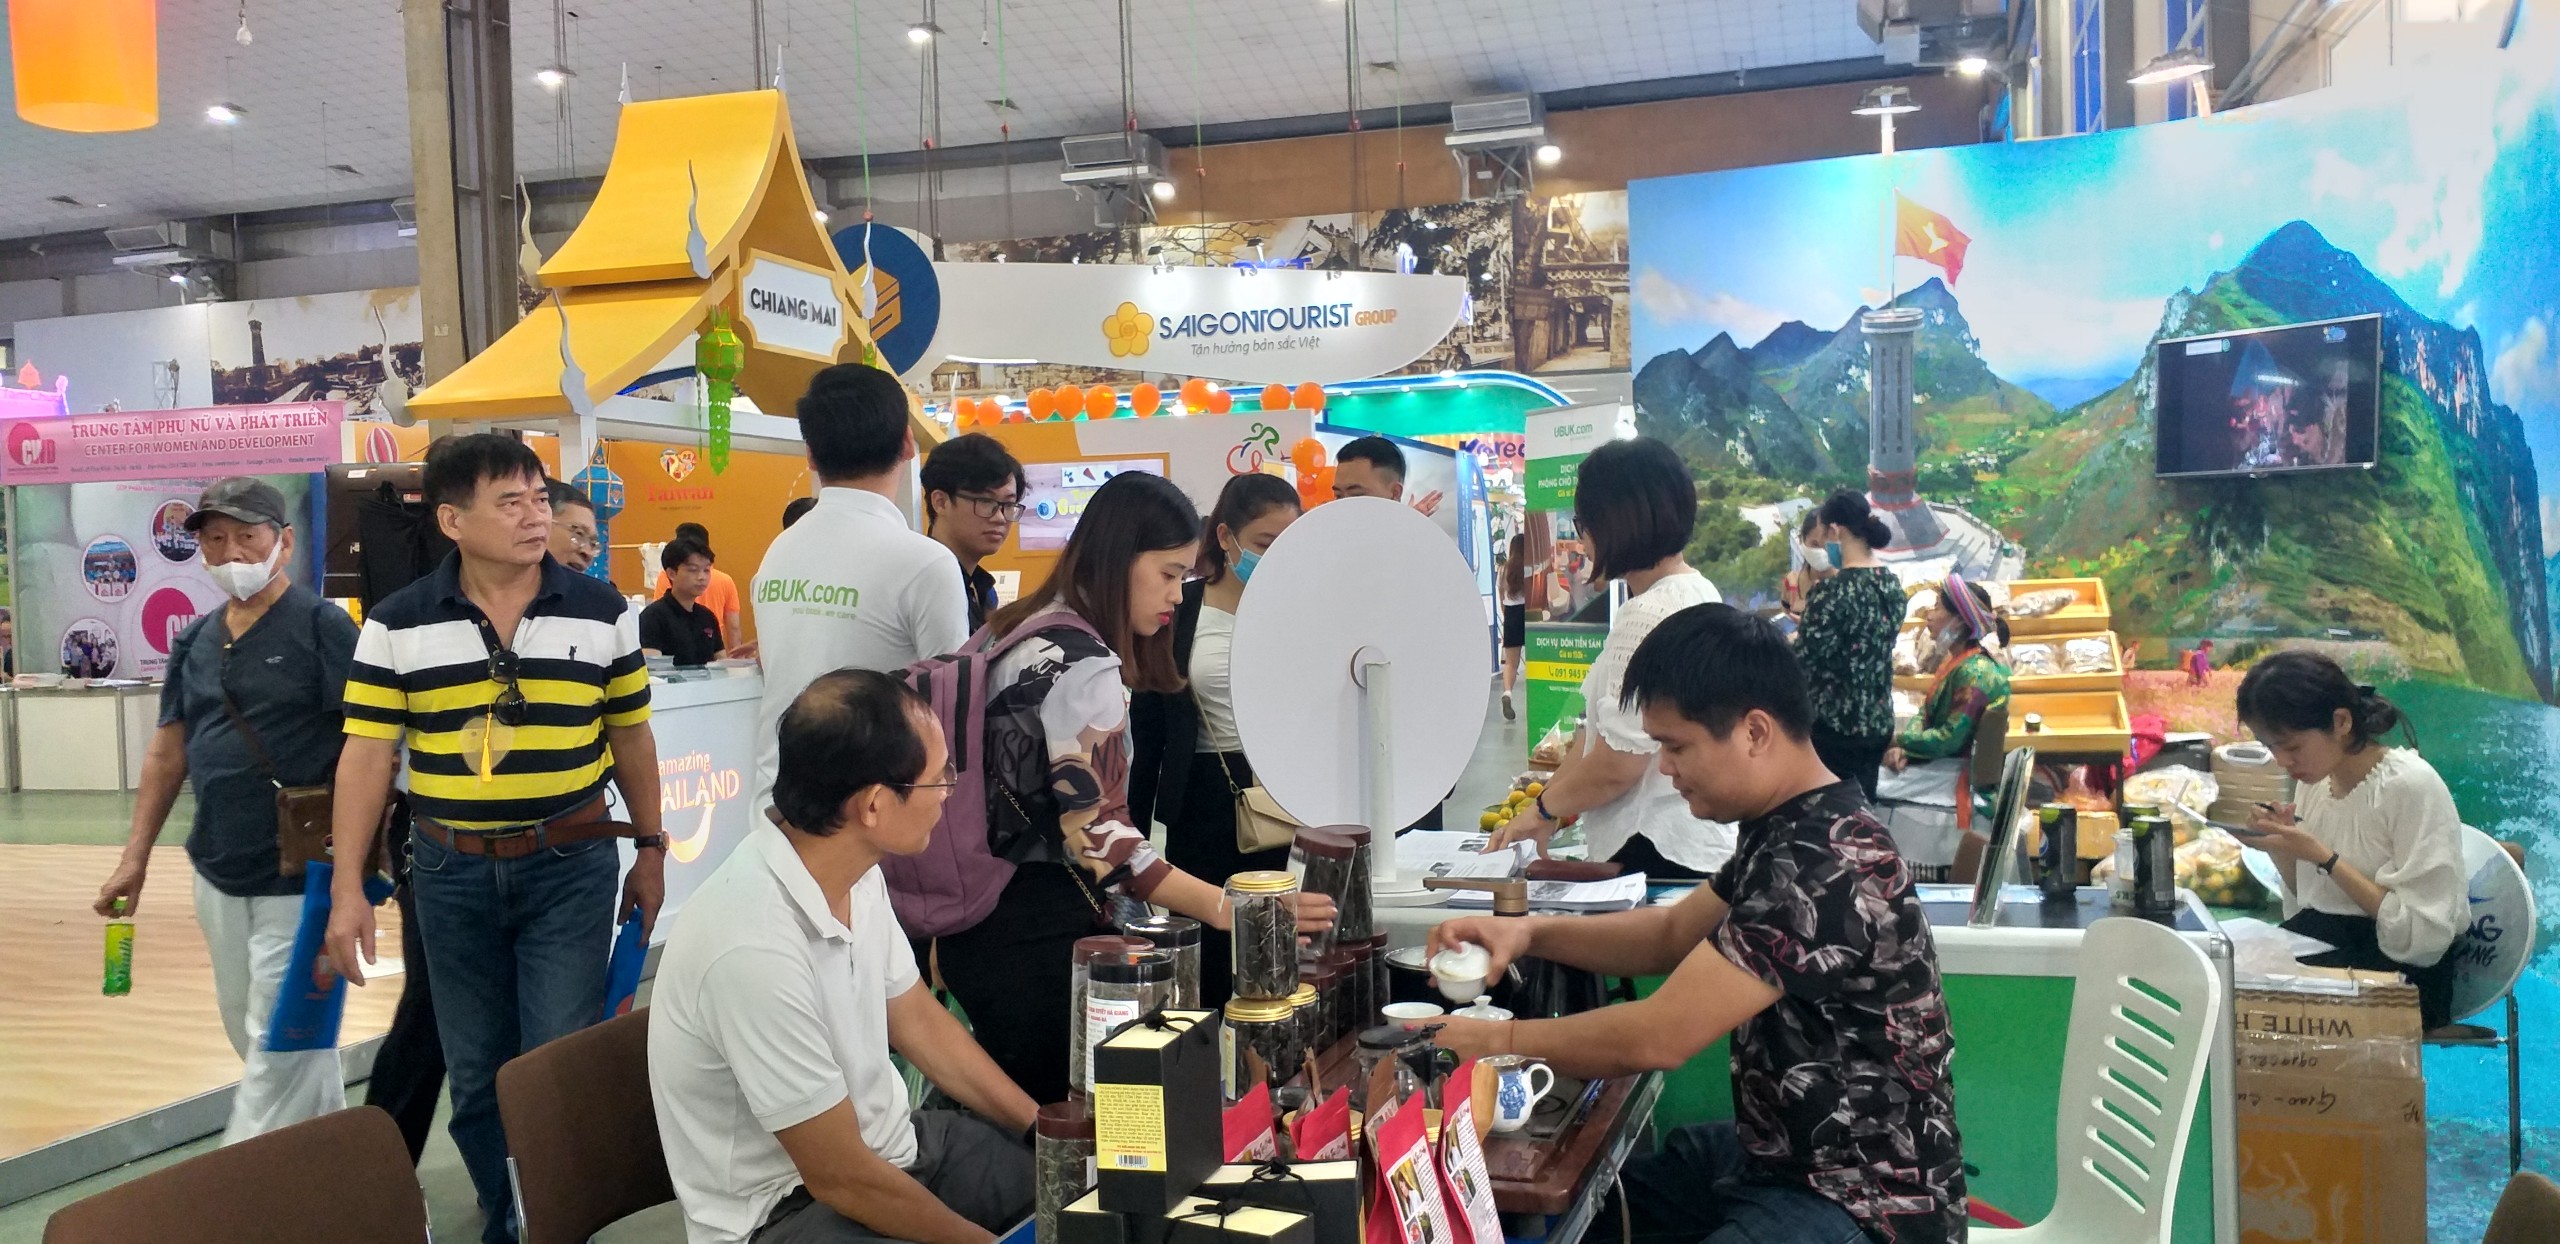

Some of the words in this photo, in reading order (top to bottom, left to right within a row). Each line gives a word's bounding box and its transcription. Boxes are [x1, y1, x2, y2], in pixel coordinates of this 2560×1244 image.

[750, 288, 808, 321] CHIANG
[810, 302, 837, 328] MAI
[1159, 303, 1353, 340] SAIGONTOURIST
[1355, 308, 1398, 326] GROUP
[1277, 334, 1297, 350] sắc
[1299, 334, 1320, 349] Việt
[72, 423, 119, 438] TRUNG
[123, 417, 153, 436] TÂM
[157, 419, 185, 437] PHỤ
[191, 414, 211, 432] NỮ
[215, 413, 236, 431] VÀ
[240, 411, 278, 430] PHÁT
[283, 404, 328, 428] TRIỂN
[84, 443, 126, 456] CENTER
[129, 442, 151, 454] FOR
[153, 440, 198, 453] WOMEN
[201, 439, 226, 450] AND
[229, 434, 315, 450] DEVELOPMENT
[648, 485, 714, 502] Taiwan
[758, 579, 859, 608] UBUK.com
[1555, 668, 1567, 678] 091
[658, 750, 710, 777] amazing
[661, 769, 740, 813] AILAND
[2262, 1013, 2354, 1038] WHITE
